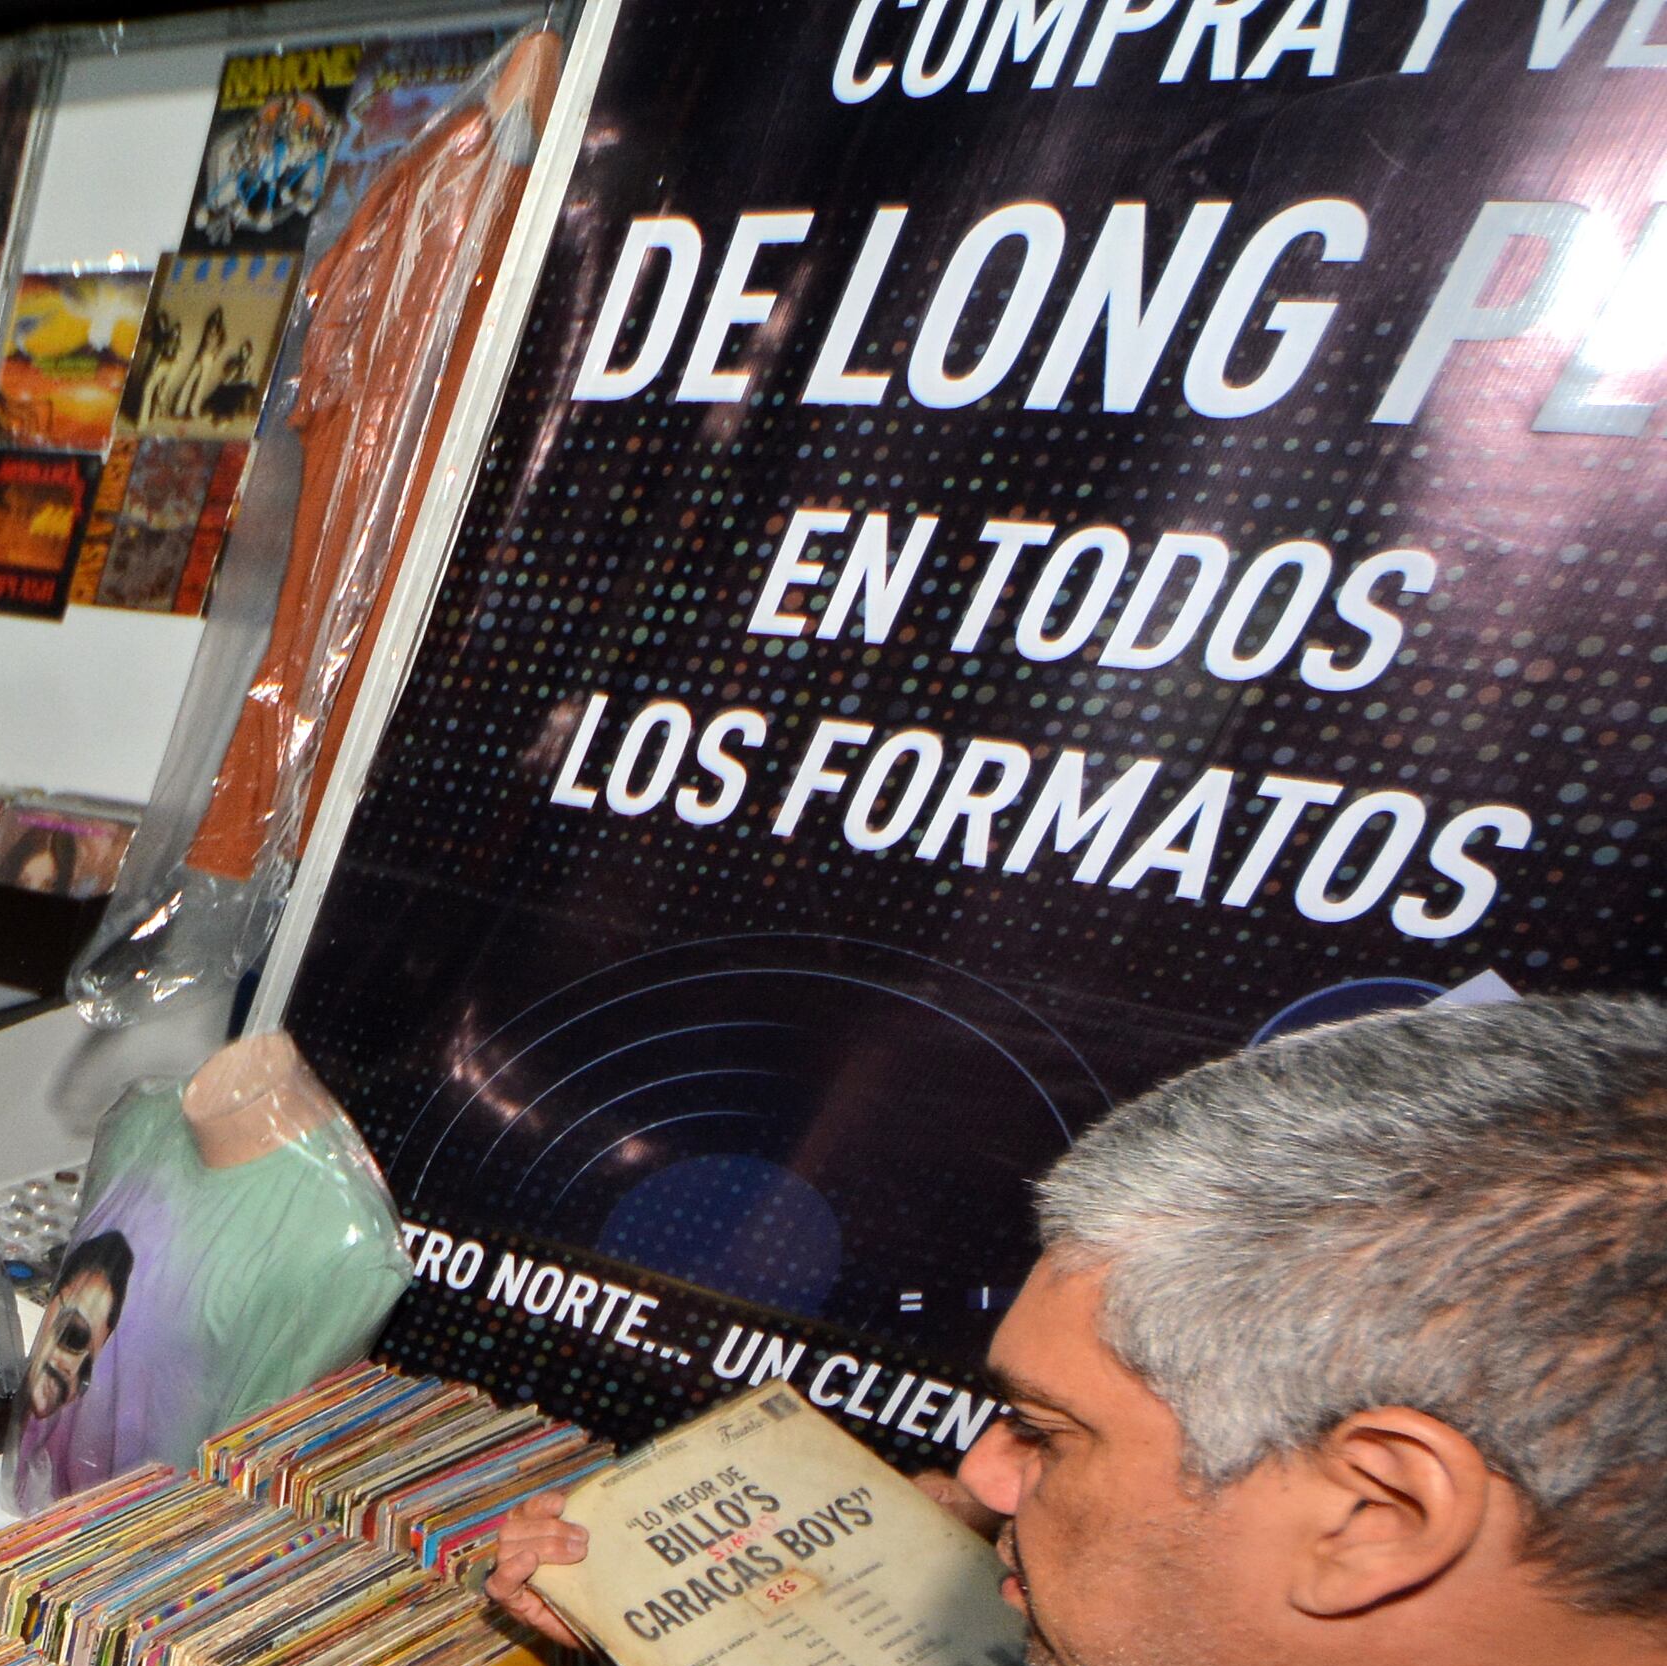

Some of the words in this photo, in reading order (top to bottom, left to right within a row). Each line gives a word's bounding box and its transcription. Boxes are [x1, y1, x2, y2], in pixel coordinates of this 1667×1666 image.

[830, 0, 1353, 103] COMPRA
[1395, 0, 1503, 74] Y
[572, 208, 814, 405] DE
[802, 198, 1369, 420] LONG
[748, 509, 939, 643] EN
[950, 521, 1438, 692] TODOS
[549, 693, 767, 826] LOS
[771, 719, 1533, 940] FORMATOS
[488, 1255, 692, 1366] NORTE...
[712, 1324, 808, 1386] UN
[645, 1484, 781, 1568] BILLO'S
[662, 1479, 717, 1516] MEJOR
[721, 1464, 748, 1496] DE
[623, 1545, 785, 1643] CARACAS
